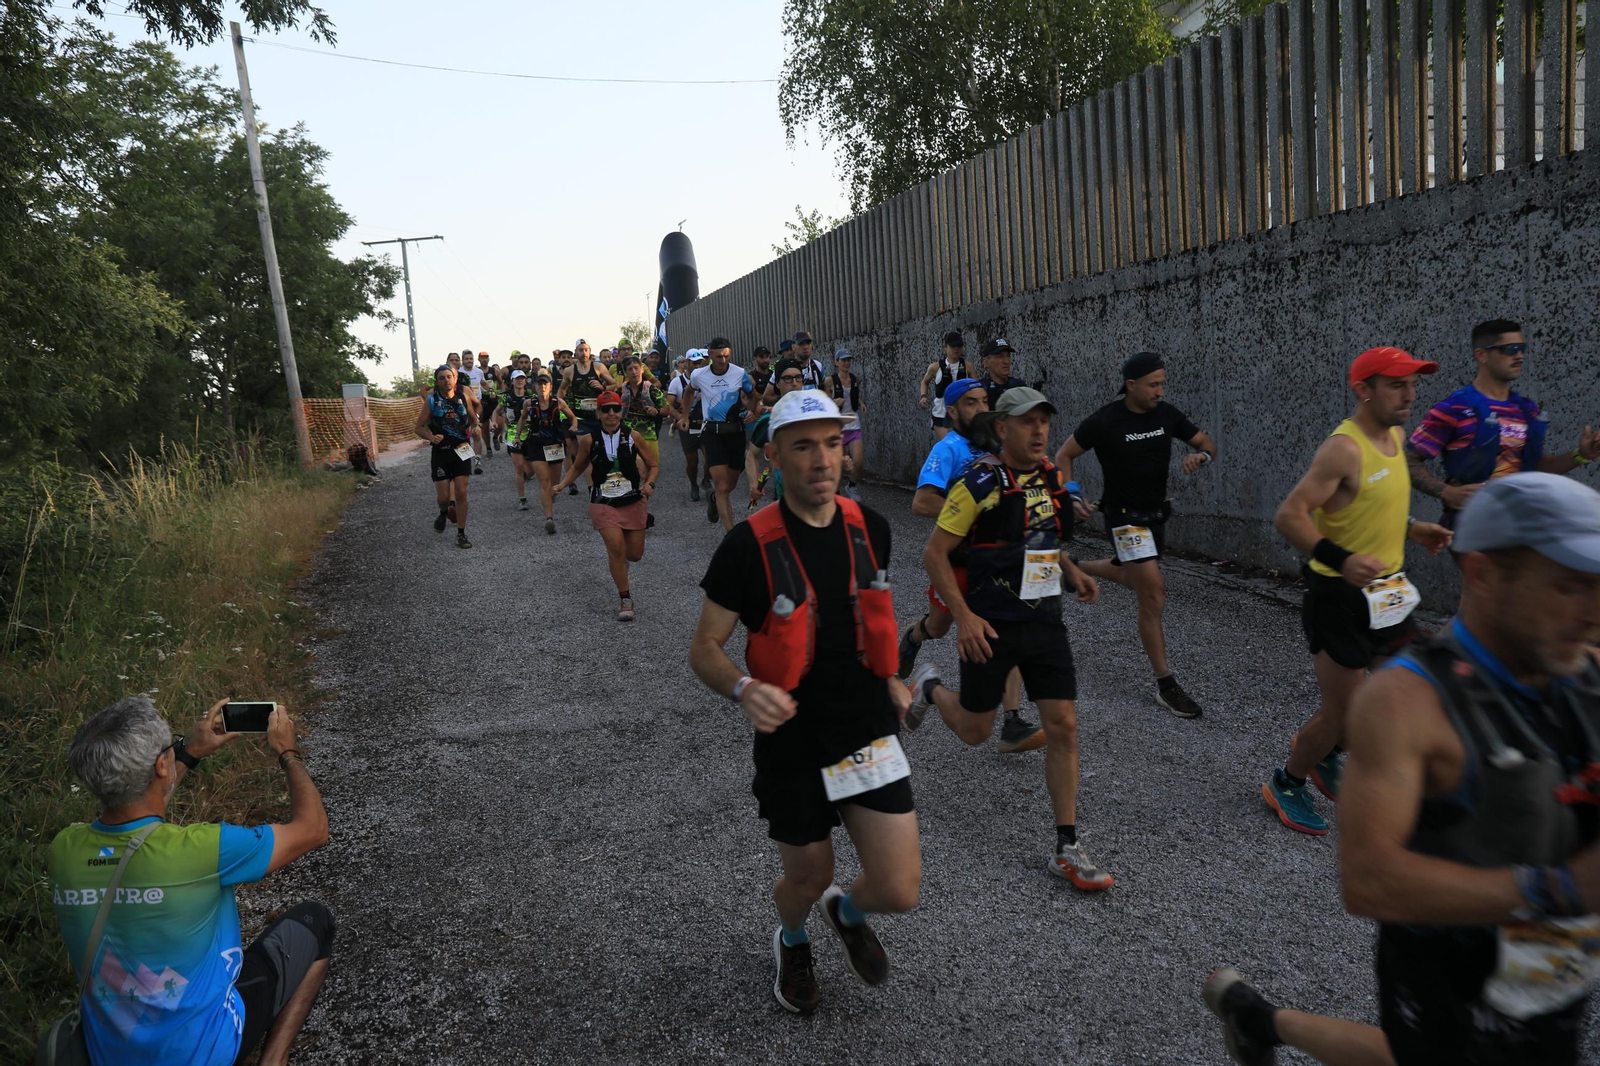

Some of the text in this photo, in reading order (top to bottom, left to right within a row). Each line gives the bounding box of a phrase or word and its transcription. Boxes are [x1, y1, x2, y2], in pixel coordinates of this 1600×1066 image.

[610, 480, 621, 488] 32
[1128, 535, 1142, 545] 19
[88, 858, 106, 867] FGM
